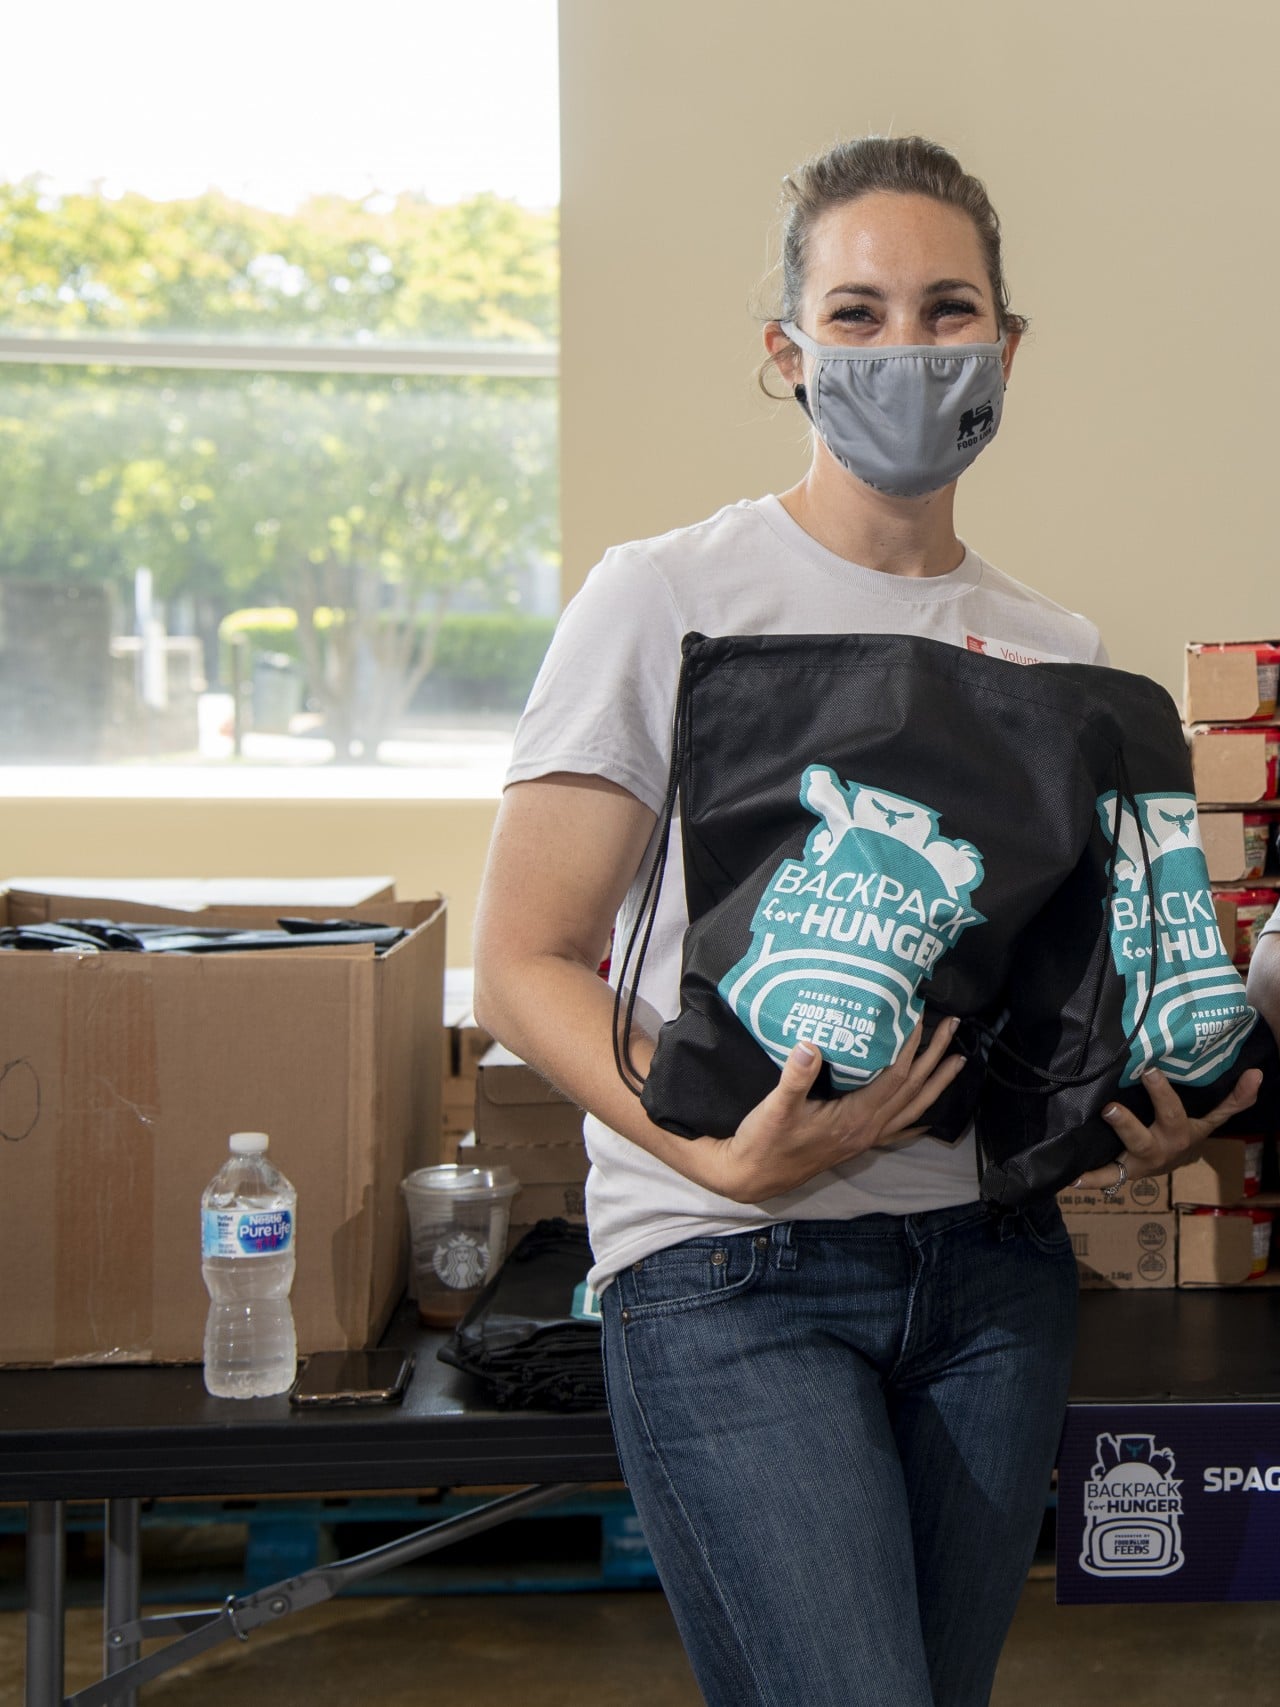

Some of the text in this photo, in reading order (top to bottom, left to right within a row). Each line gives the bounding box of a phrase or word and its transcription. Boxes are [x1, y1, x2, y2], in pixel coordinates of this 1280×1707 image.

[957, 437, 978, 451] FOOD
[774, 864, 976, 940] BACKPACK
[1111, 890, 1217, 931] BACK
[762, 898, 944, 970] for HUNGER
[798, 990, 882, 1017] PRESENTED BY
[1192, 1005, 1245, 1019] PRESENTED
[790, 1002, 876, 1035] FOOD LION
[782, 1014, 872, 1059] FEEDS
[1194, 1021, 1222, 1036] FOOD
[240, 1225, 272, 1238] Pure
[273, 1222, 291, 1239] Life
[1087, 1482, 1178, 1498] BACKPACK
[1088, 1499, 1180, 1513] for HUNGER
[1114, 1546, 1150, 1555] FEEDS
